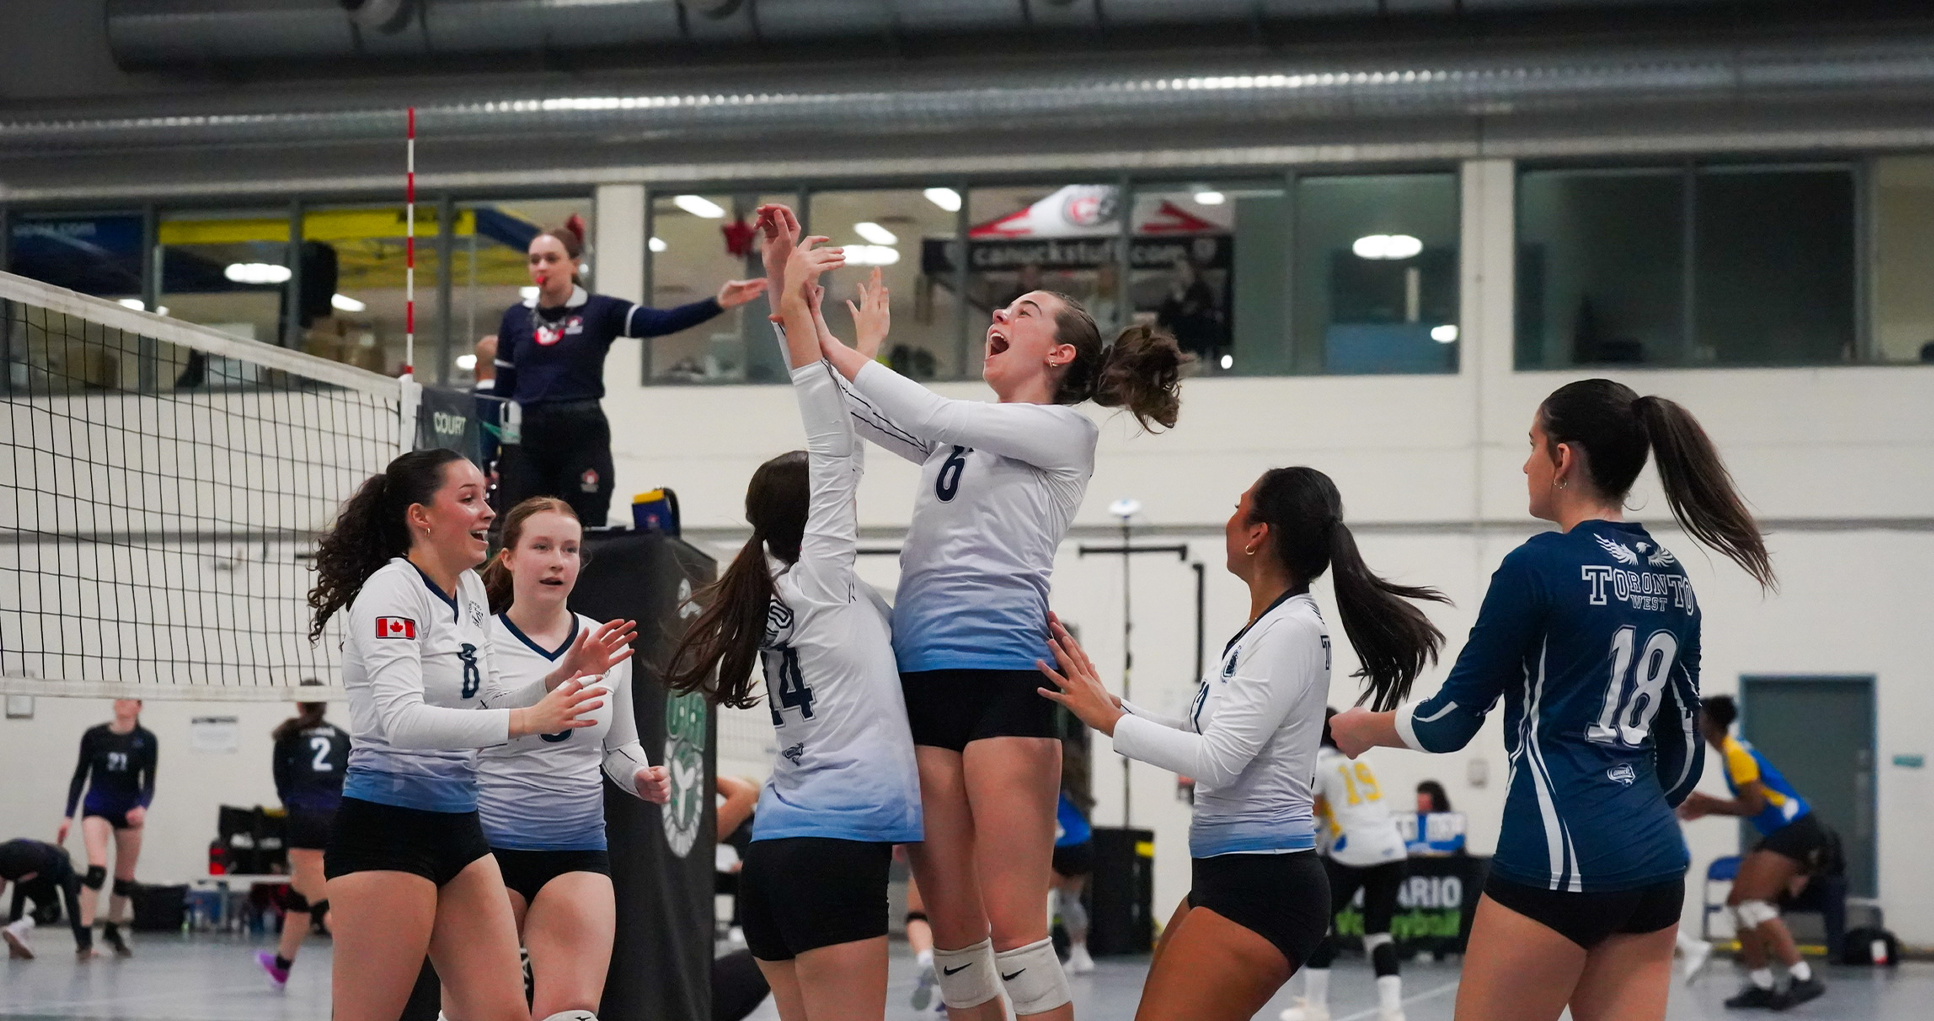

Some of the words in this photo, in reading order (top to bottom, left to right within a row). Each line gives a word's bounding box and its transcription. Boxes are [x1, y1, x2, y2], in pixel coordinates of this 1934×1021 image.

[973, 240, 1187, 265] canuckstuffcom
[433, 411, 466, 435] COURT
[934, 444, 974, 504] 6
[1581, 564, 1694, 616] TORONTO
[1630, 594, 1668, 612] WEST
[1584, 623, 1679, 749] 18
[310, 736, 333, 772] 2
[1337, 762, 1384, 806] 19
